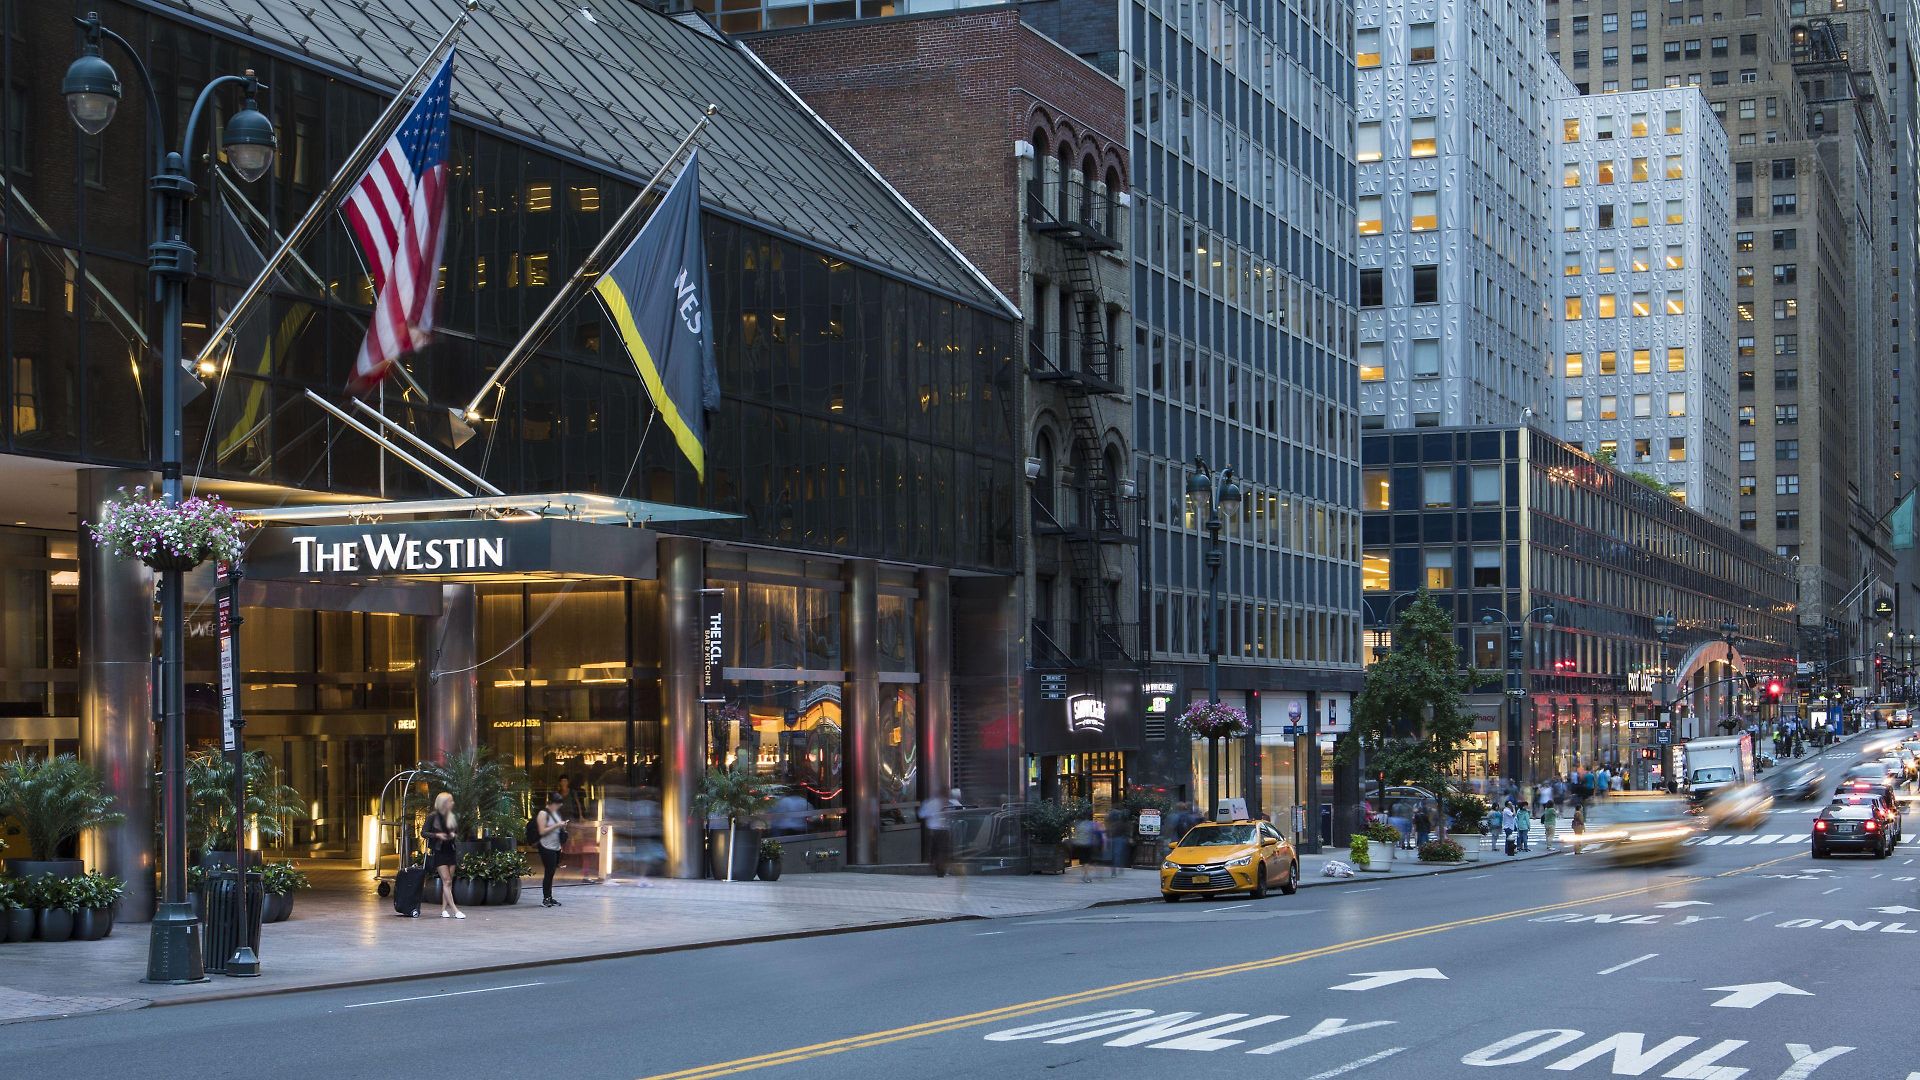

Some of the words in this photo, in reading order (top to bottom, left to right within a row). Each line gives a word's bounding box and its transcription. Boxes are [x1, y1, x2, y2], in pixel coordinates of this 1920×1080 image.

[674, 266, 702, 345] WES
[292, 536, 360, 573] THE
[362, 533, 504, 570] WESTIN
[710, 612, 721, 638] THE
[1527, 913, 1728, 925] ONLY
[983, 1008, 1398, 1055] ONLY
[1460, 1028, 1858, 1080] ONLY
